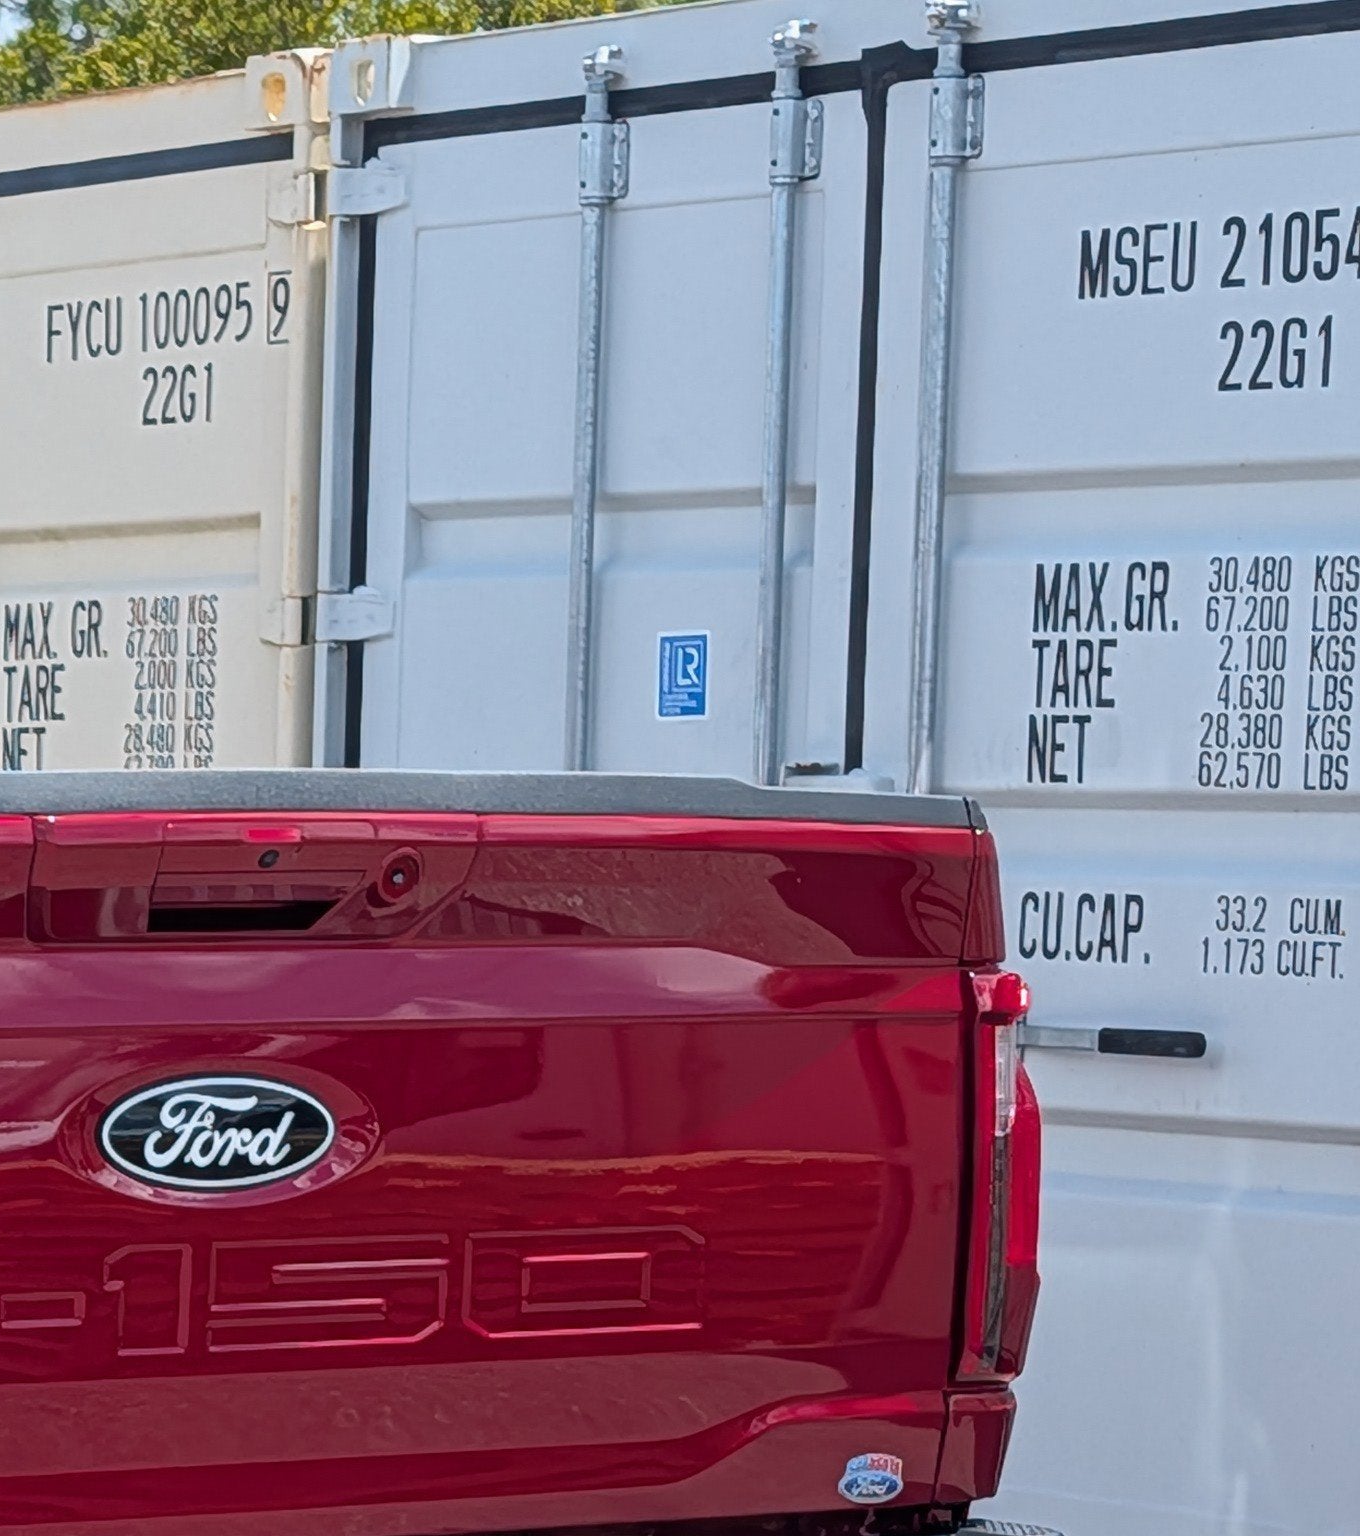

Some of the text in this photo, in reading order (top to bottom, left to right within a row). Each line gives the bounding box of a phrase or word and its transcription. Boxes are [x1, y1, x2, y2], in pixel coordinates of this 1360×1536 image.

[1078, 220, 1198, 300] MSEU
[46, 295, 122, 364] FYCU
[138, 281, 254, 352] 100095
[1217, 314, 1333, 391] 22G1
[141, 361, 213, 426] 22G1
[1313, 555, 1360, 593] KGS
[70, 600, 108, 658] GR.
[187, 594, 219, 625] KGS
[1311, 595, 1358, 632] LBS
[186, 627, 218, 657] LBS
[1309, 634, 1356, 672] KGS
[2, 663, 66, 723] TARE
[185, 659, 217, 689] KGS
[1031, 638, 1118, 709] TARE
[1307, 674, 1354, 712] LBS
[184, 691, 215, 721] LBS
[183, 722, 215, 753] KGS
[1026, 713, 1092, 784] NET
[1305, 713, 1352, 751] KGS
[1303, 752, 1350, 791] LBS
[1019, 891, 1151, 964] CU.CAP.
[1215, 894, 1268, 933] 33.2
[144, 1093, 296, 1168] Ford
